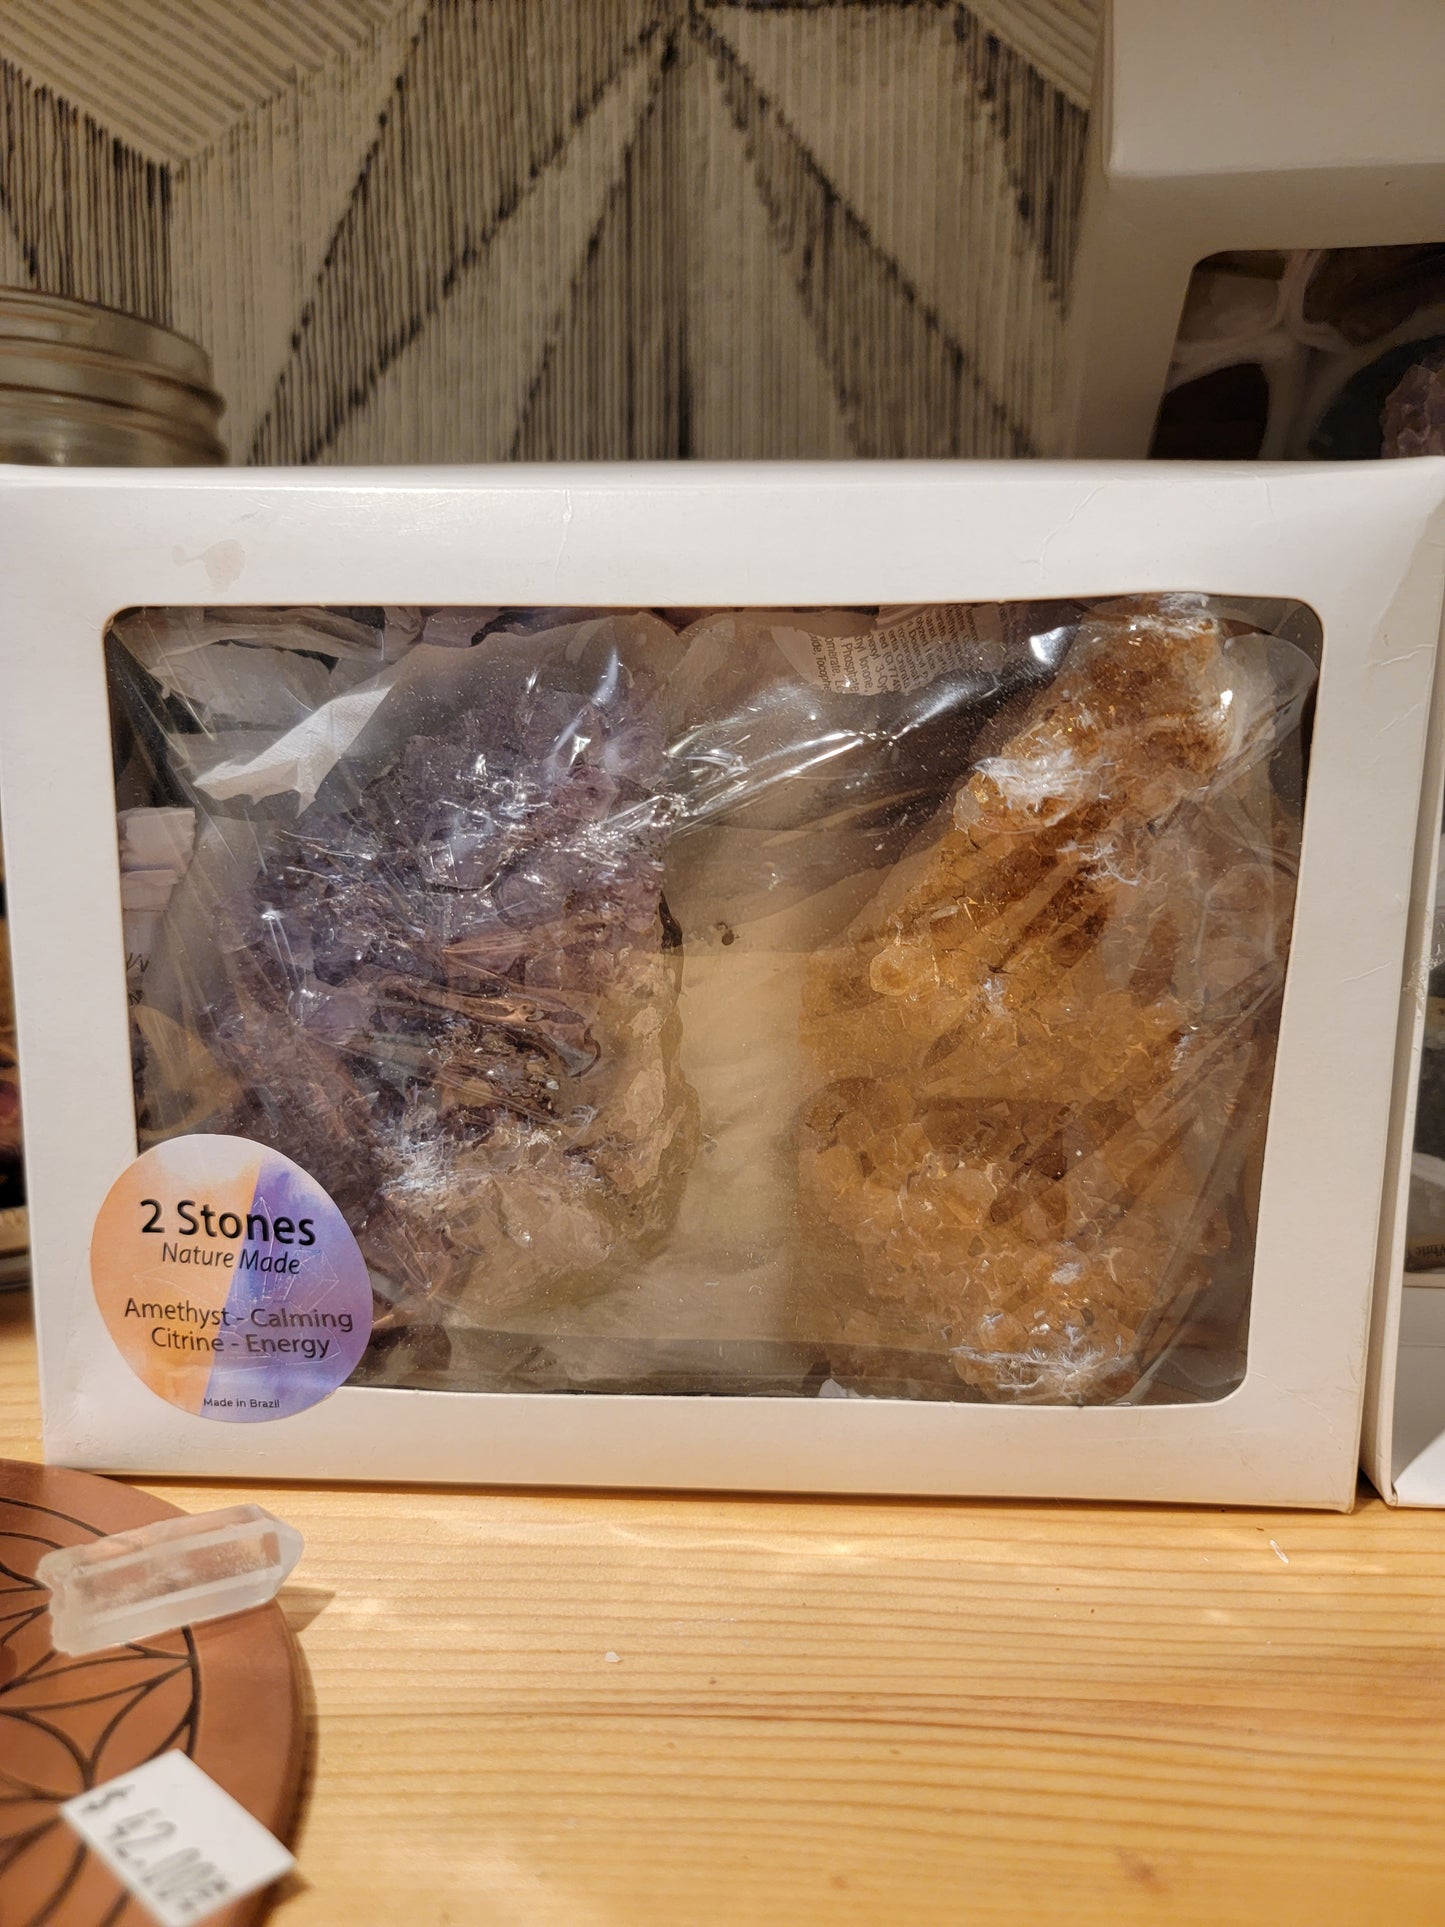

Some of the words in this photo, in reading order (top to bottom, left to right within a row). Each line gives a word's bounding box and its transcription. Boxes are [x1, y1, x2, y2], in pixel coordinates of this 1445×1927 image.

[140, 1199, 165, 1234] 2
[177, 1200, 316, 1246] Stones
[162, 1242, 234, 1268] Nature
[240, 1252, 300, 1274] Made
[124, 1297, 230, 1329] Amethyst
[250, 1308, 353, 1332] Calming
[151, 1327, 225, 1352] Citrine
[246, 1334, 330, 1358] Energy
[204, 1398, 233, 1407] Made
[236, 1398, 246, 1407] in
[250, 1399, 280, 1408] Brazil
